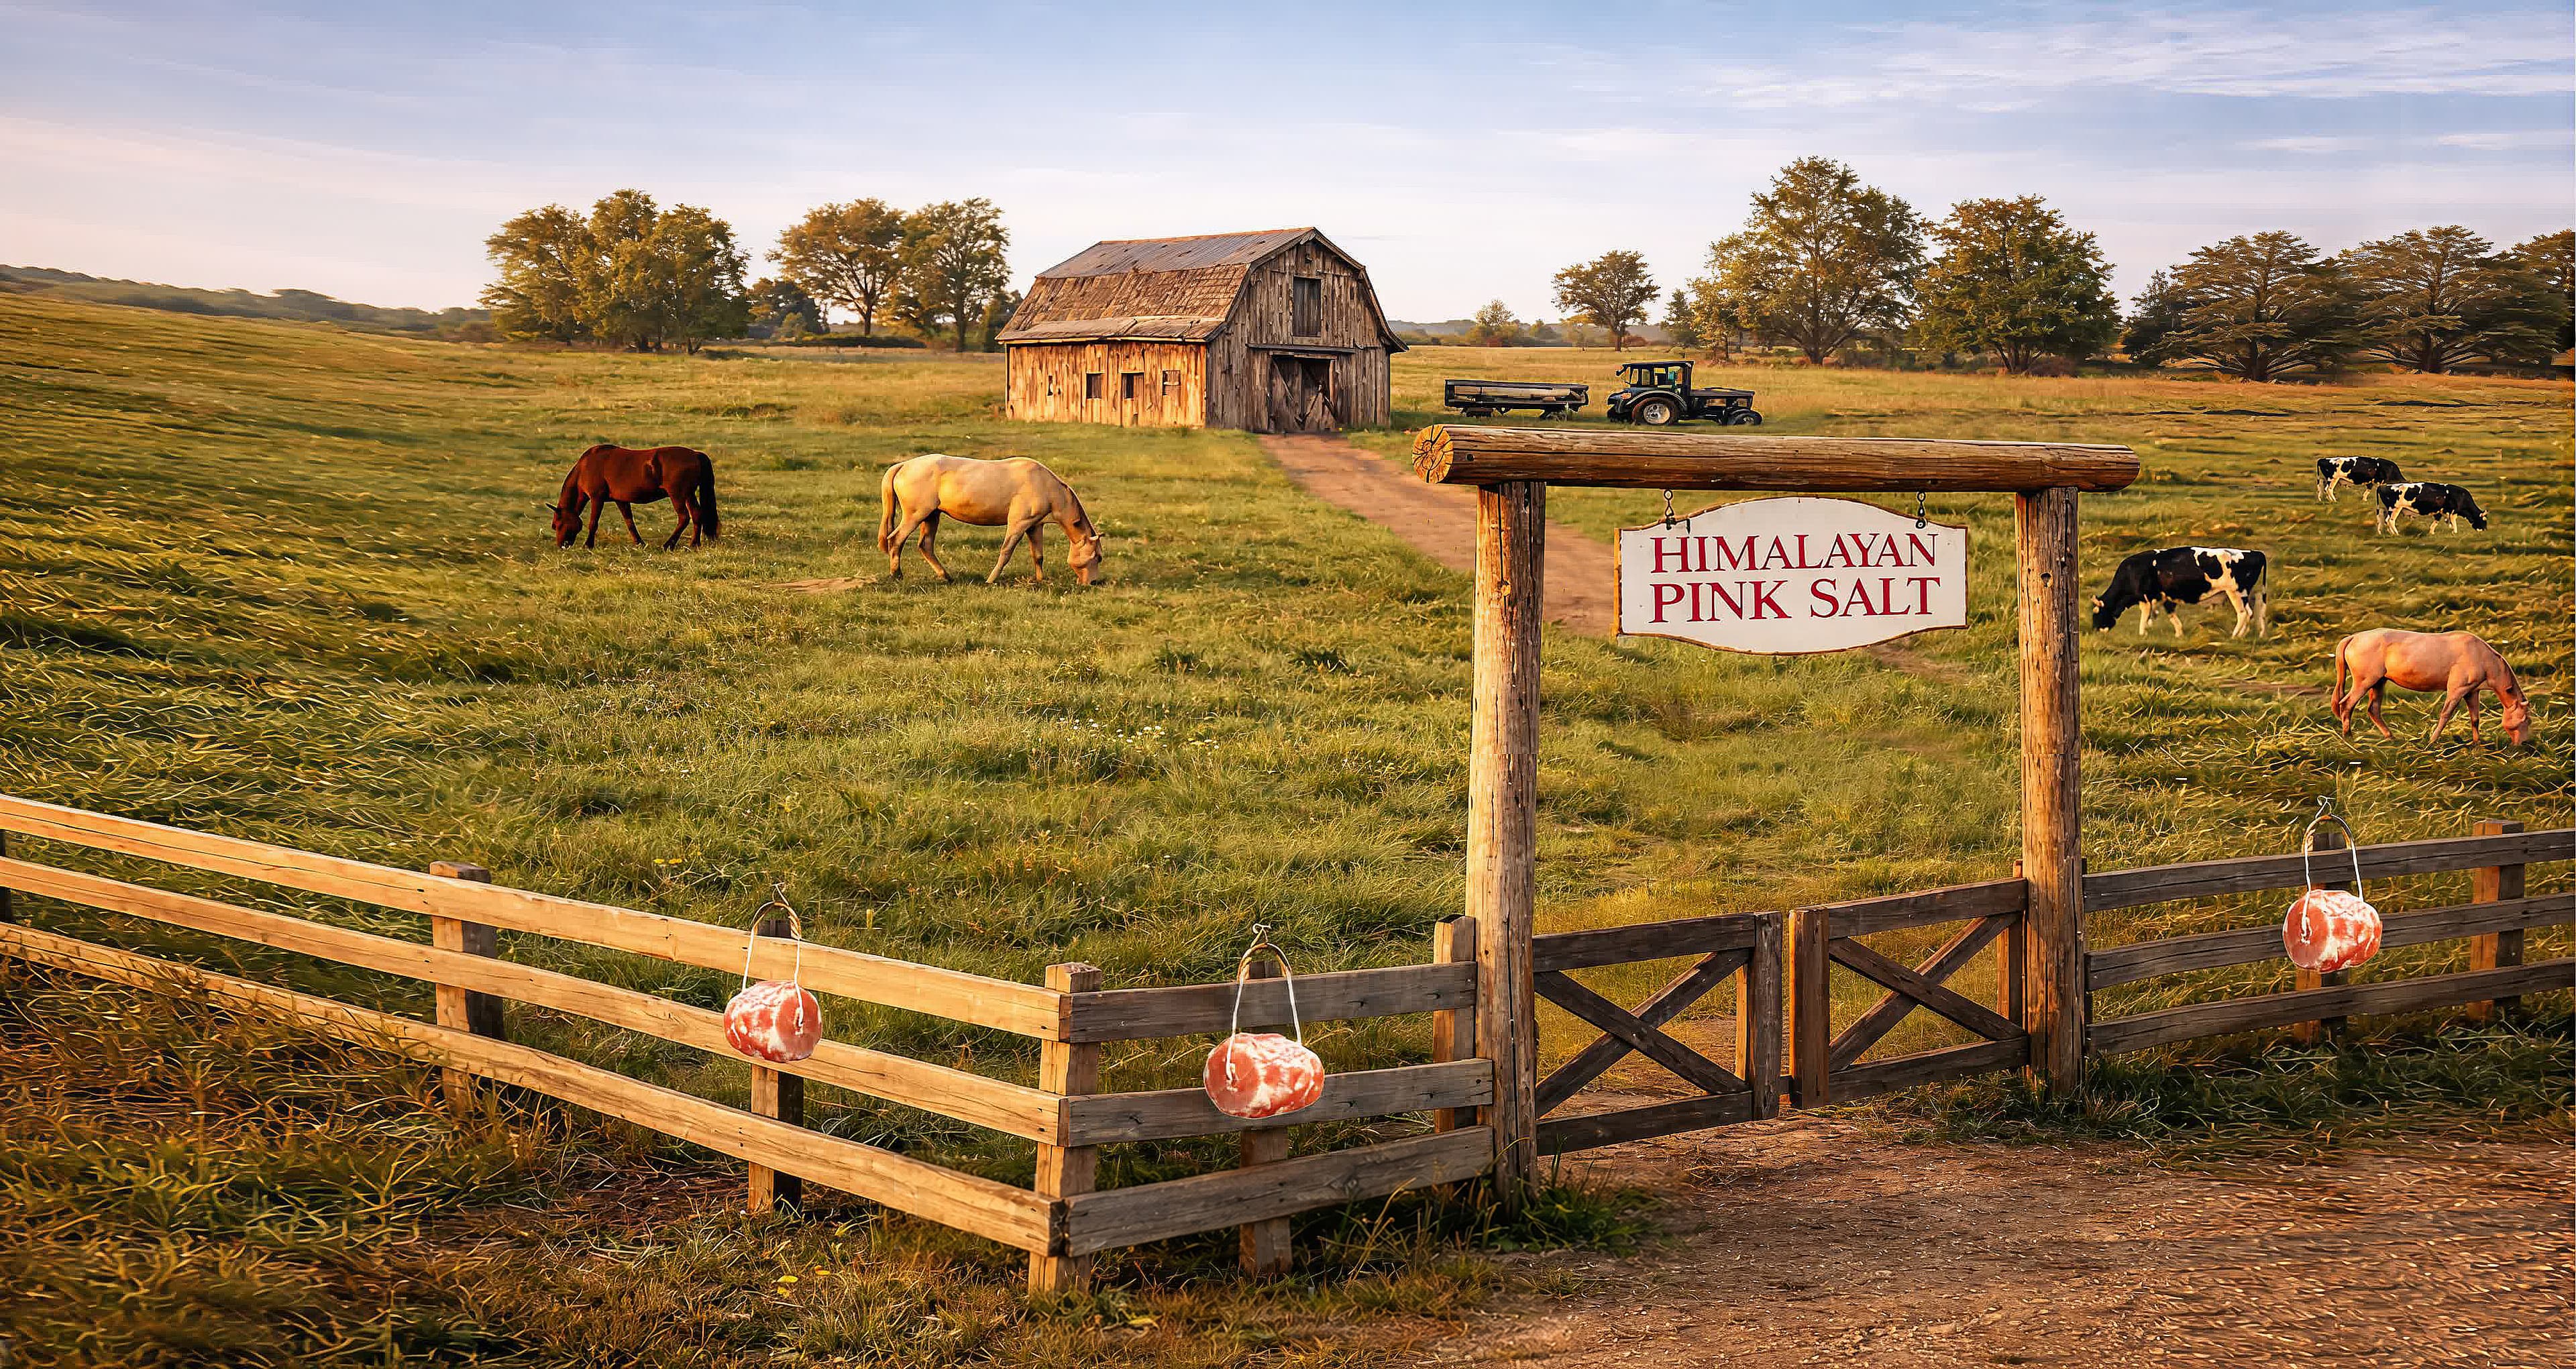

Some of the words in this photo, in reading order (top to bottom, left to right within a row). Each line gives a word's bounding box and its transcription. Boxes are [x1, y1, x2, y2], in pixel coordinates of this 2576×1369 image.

[1650, 533, 1939, 573] HIMALAYAN
[1648, 580, 1792, 624] PINK
[1810, 577, 1941, 618] SALT
